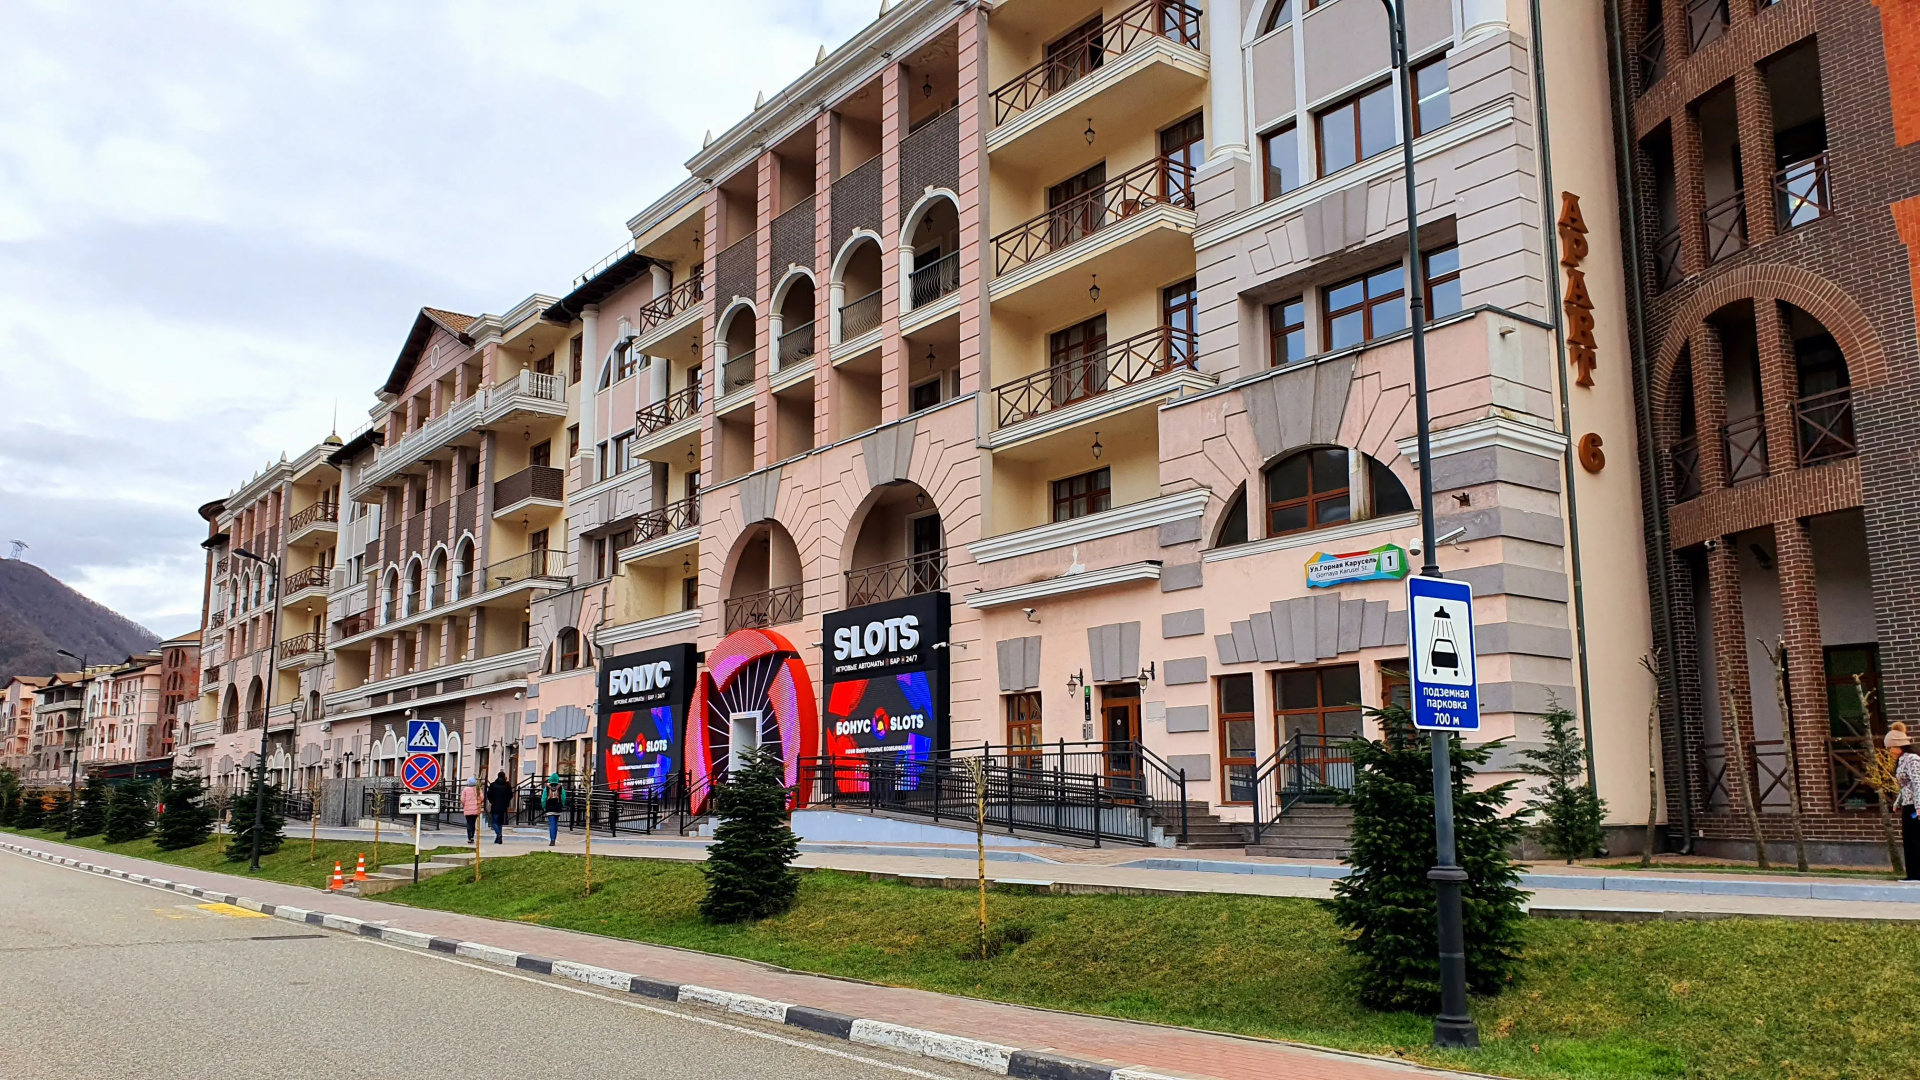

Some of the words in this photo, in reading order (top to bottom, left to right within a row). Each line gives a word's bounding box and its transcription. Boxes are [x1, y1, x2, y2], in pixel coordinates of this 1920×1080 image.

[1558, 191, 1598, 389] APART
[1578, 432, 1606, 473] 6
[1344, 557, 1376, 568] Карусель
[1387, 555, 1392, 566] 1
[1316, 570, 1338, 578] Gornaya
[1340, 566, 1360, 574] Karusel
[834, 615, 919, 661] SLOTS
[835, 663, 858, 674] ИГРОВЫЕ
[858, 659, 885, 670] АВТОМАТЫ
[906, 654, 918, 662] 24/7
[609, 661, 671, 696] БОНУС
[1424, 687, 1470, 698] подземная
[1427, 698, 1467, 710] парковка
[890, 714, 924, 731] SLOTS
[1434, 713, 1450, 725] 700
[1453, 717, 1460, 726] м
[836, 719, 871, 736] БОНУС
[612, 742, 634, 755] БОНУС
[646, 739, 668, 752] SLOTS
